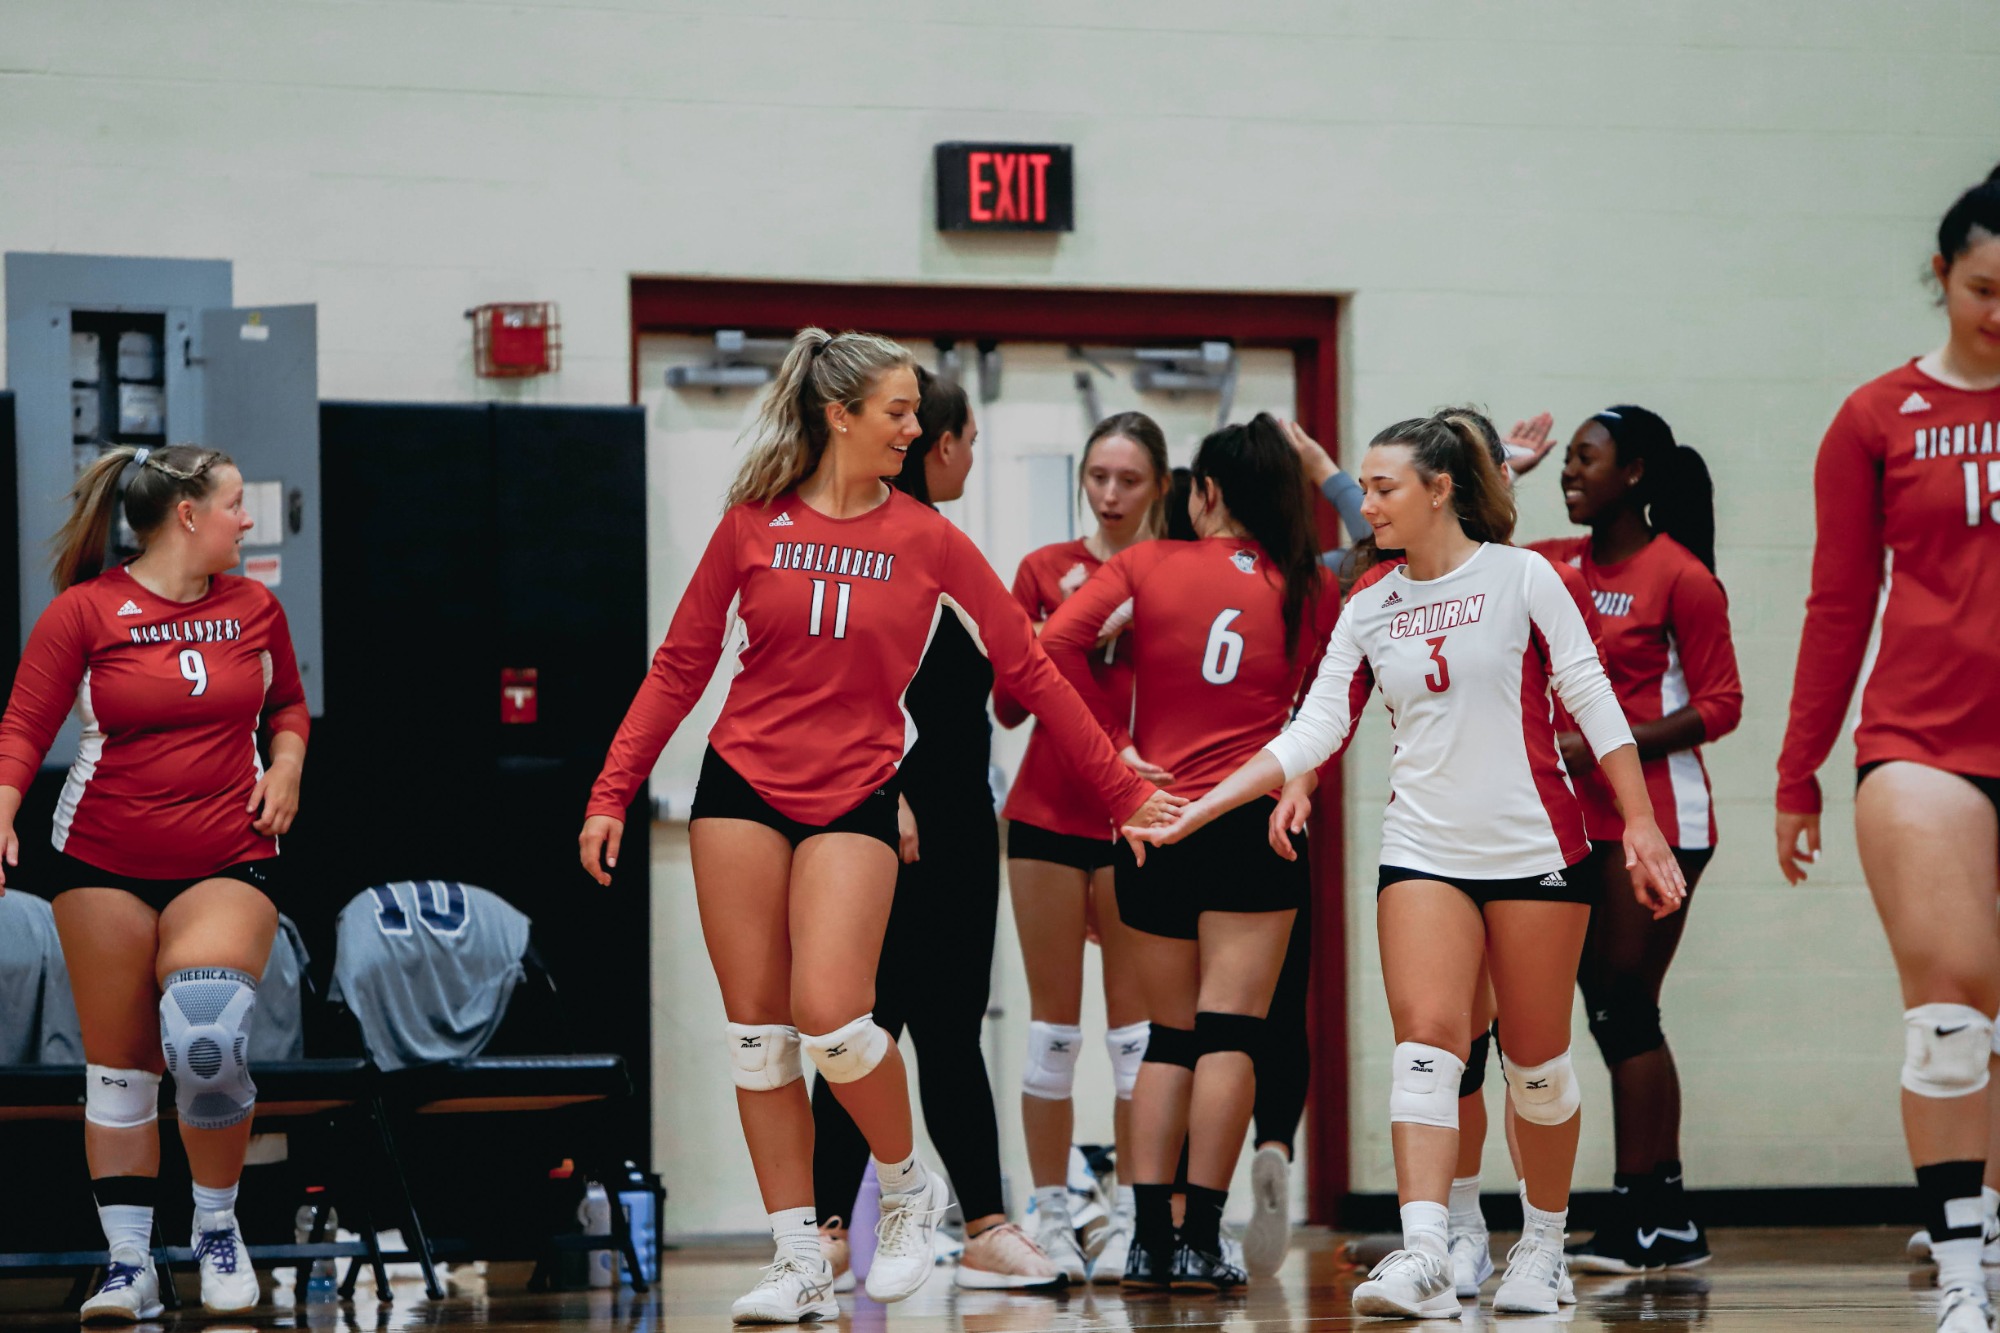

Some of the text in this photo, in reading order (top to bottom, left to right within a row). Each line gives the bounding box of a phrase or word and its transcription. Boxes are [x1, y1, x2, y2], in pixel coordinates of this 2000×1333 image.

[969, 152, 1051, 222] EXIT
[770, 542, 896, 582] HIGHLANDERS
[130, 619, 240, 643] HIGHLANDERS
[809, 578, 851, 639] 11
[1389, 593, 1485, 640] CAIRN
[1202, 607, 1244, 685] 6
[1424, 635, 1451, 693] 3
[179, 648, 208, 697] 9
[180, 969, 228, 982] NEENCA
